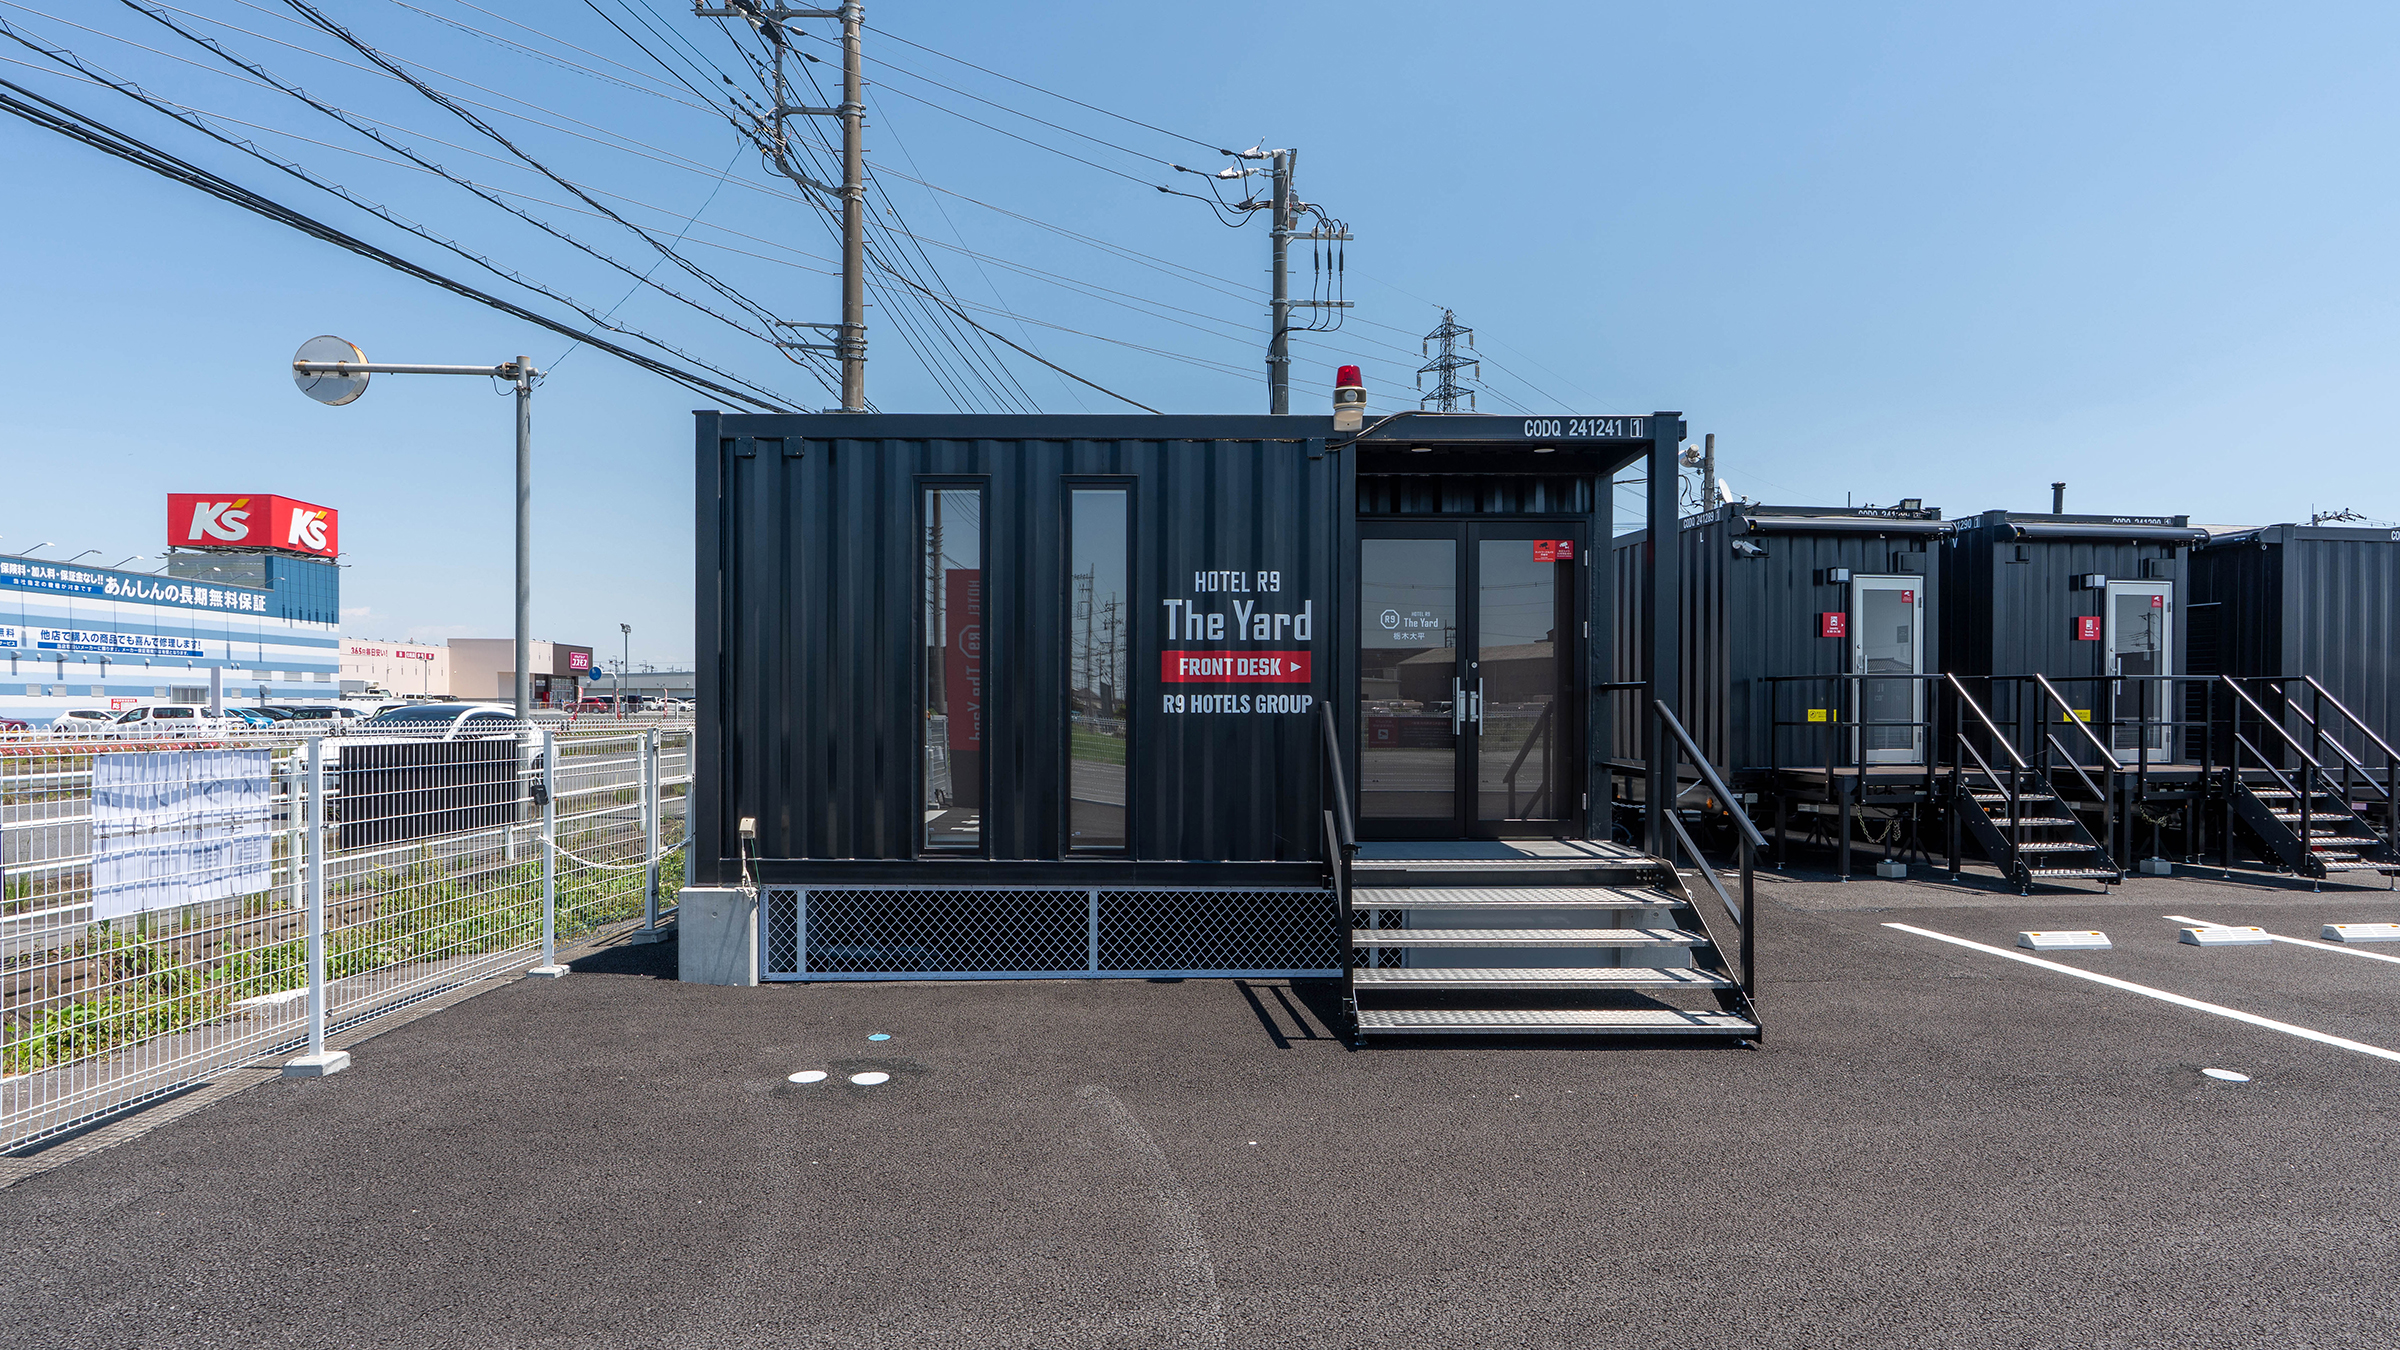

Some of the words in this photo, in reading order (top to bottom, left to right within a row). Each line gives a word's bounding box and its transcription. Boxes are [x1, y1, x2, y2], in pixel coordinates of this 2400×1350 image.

[1524, 419, 1561, 437] CODQ
[1569, 419, 1622, 437] 241241
[1194, 571, 1250, 592] HOTEL
[1257, 571, 1280, 592] R9
[104, 576, 267, 612] あんしんの長期無料保証
[1163, 599, 1224, 640] The
[1233, 599, 1312, 641] Yard
[1384, 615, 1396, 623] R9
[1404, 617, 1418, 628] The
[1420, 617, 1438, 628] Yard
[1179, 658, 1233, 676] FRONT
[1237, 658, 1281, 676] DESK
[1163, 694, 1185, 713] R9
[1190, 694, 1250, 713] HOTELS
[1255, 694, 1312, 713] GROUP
